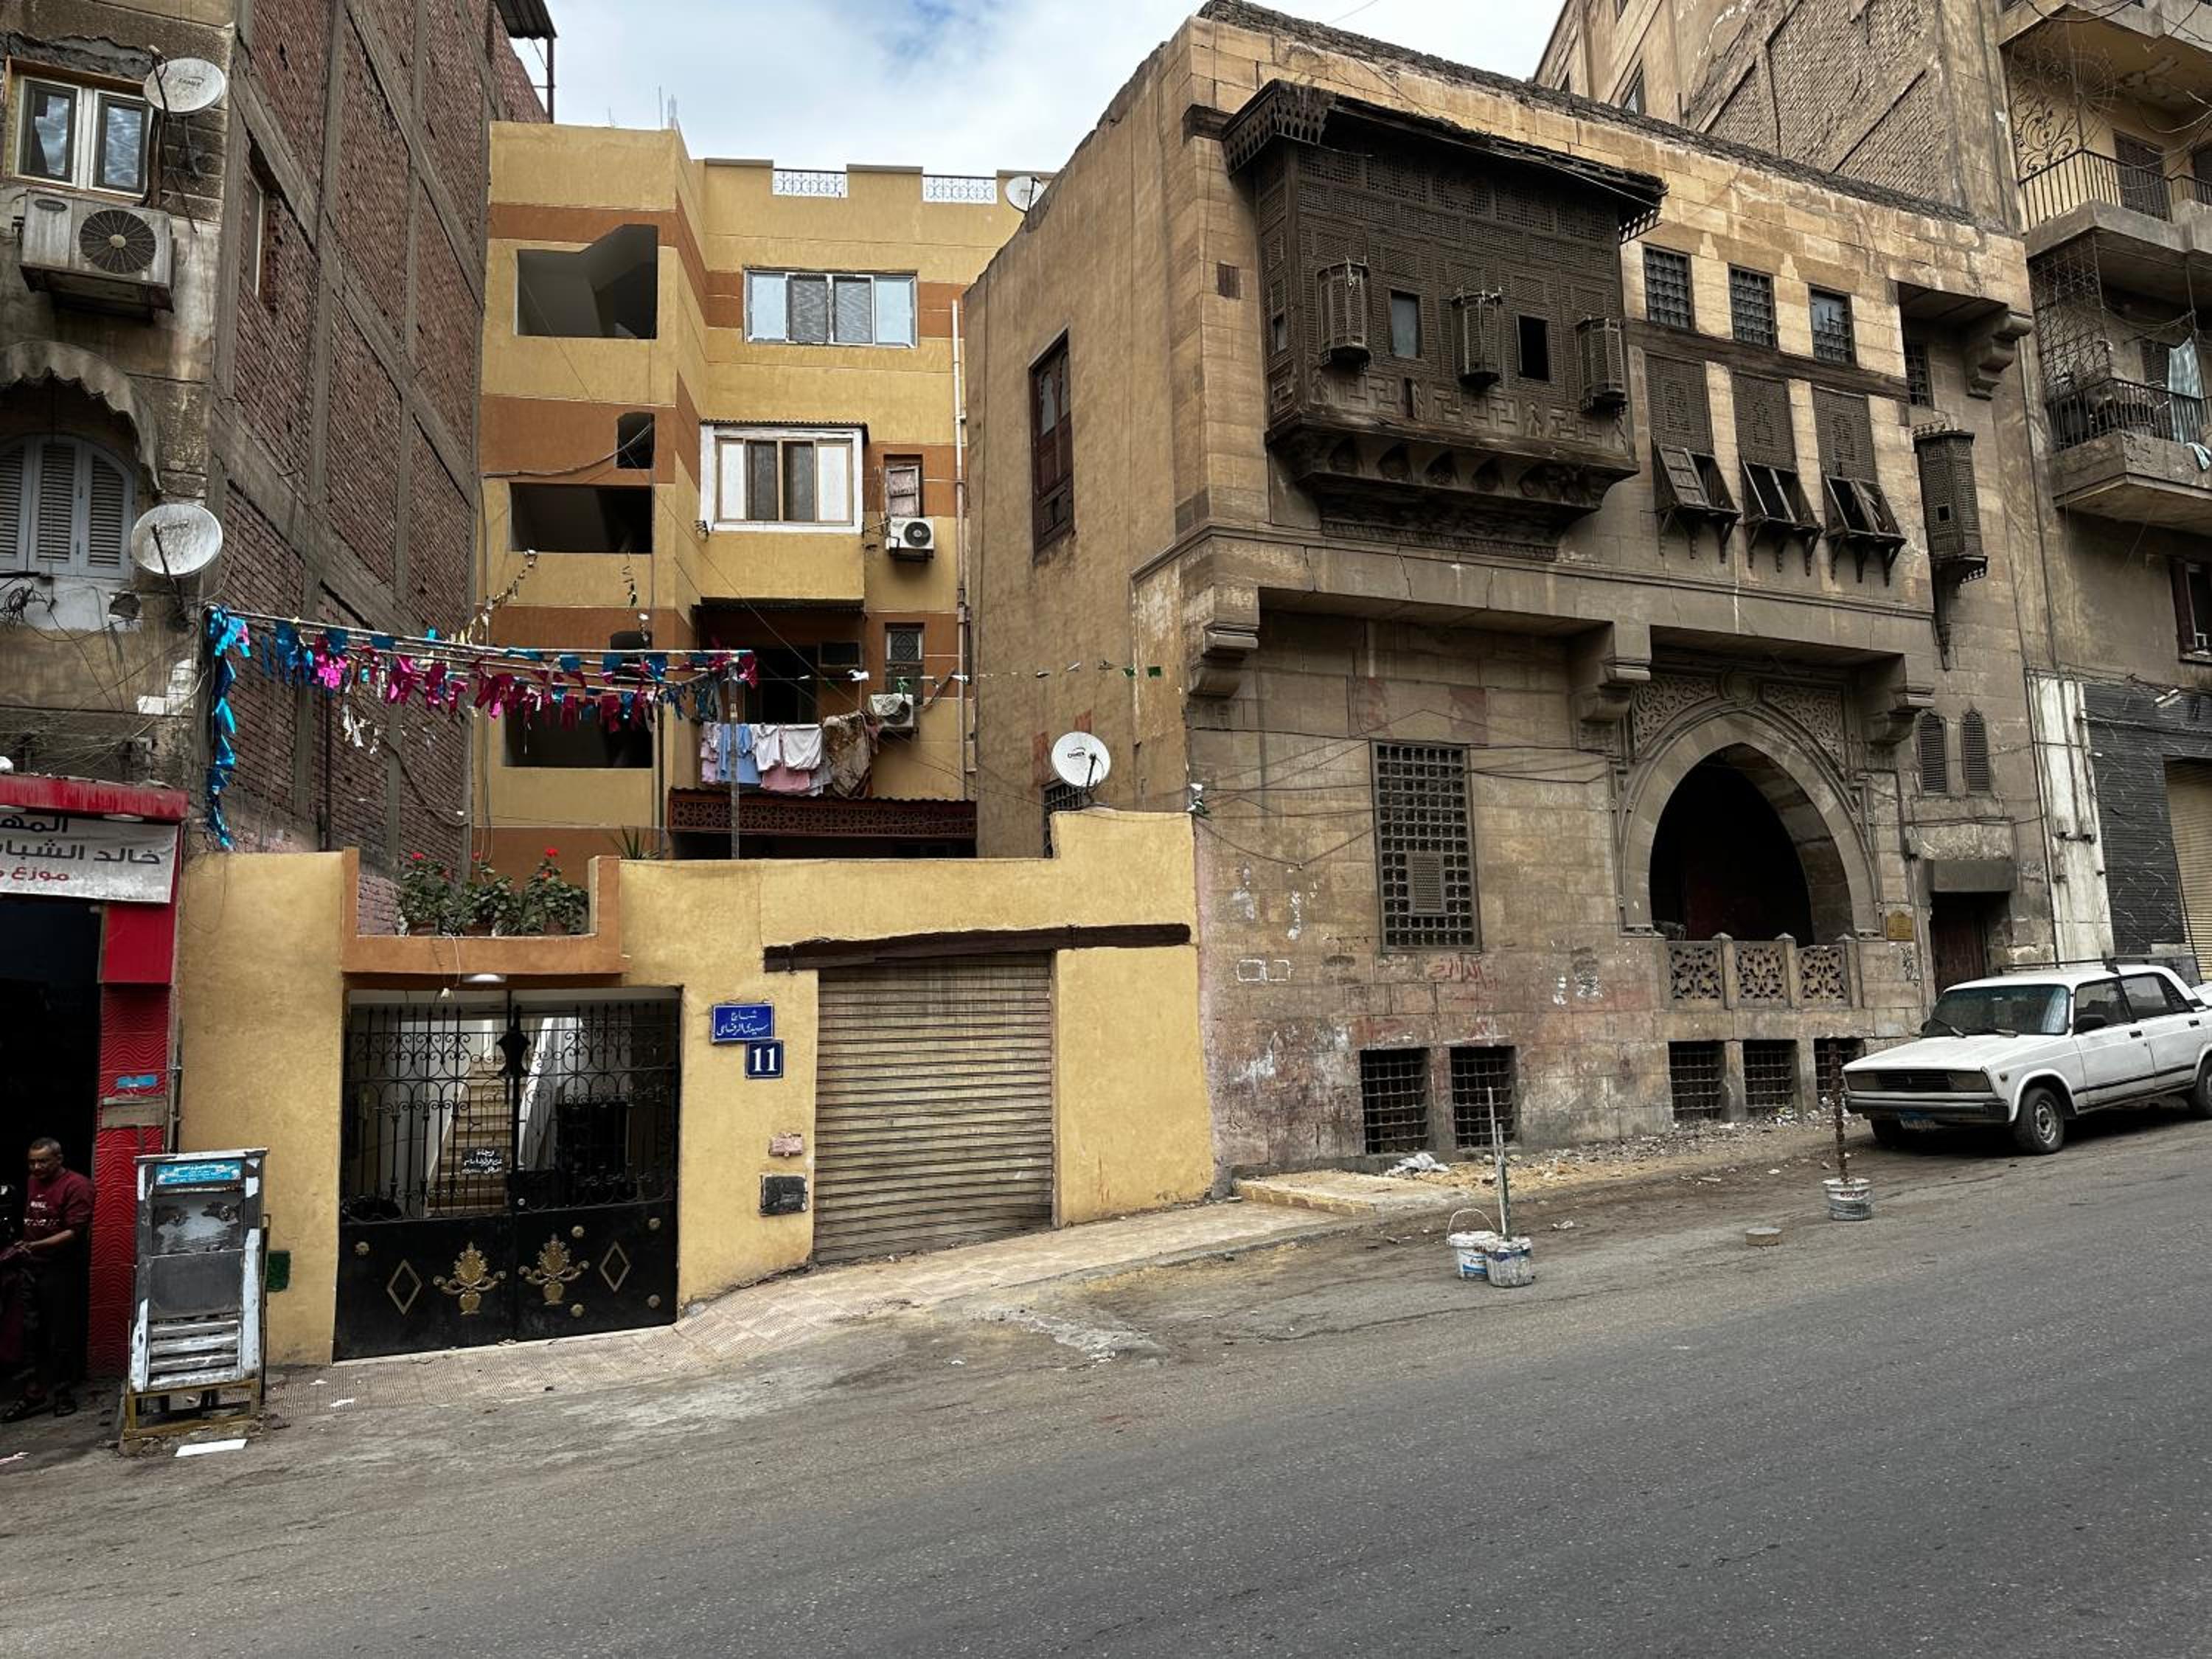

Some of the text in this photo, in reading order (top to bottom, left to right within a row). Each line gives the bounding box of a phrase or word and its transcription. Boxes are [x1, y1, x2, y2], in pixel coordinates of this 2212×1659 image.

[0, 838, 161, 865] خالد الشبا
[11, 866, 70, 881] موزع
[731, 1009, 757, 1021] شارع
[753, 1047, 778, 1071] 11
